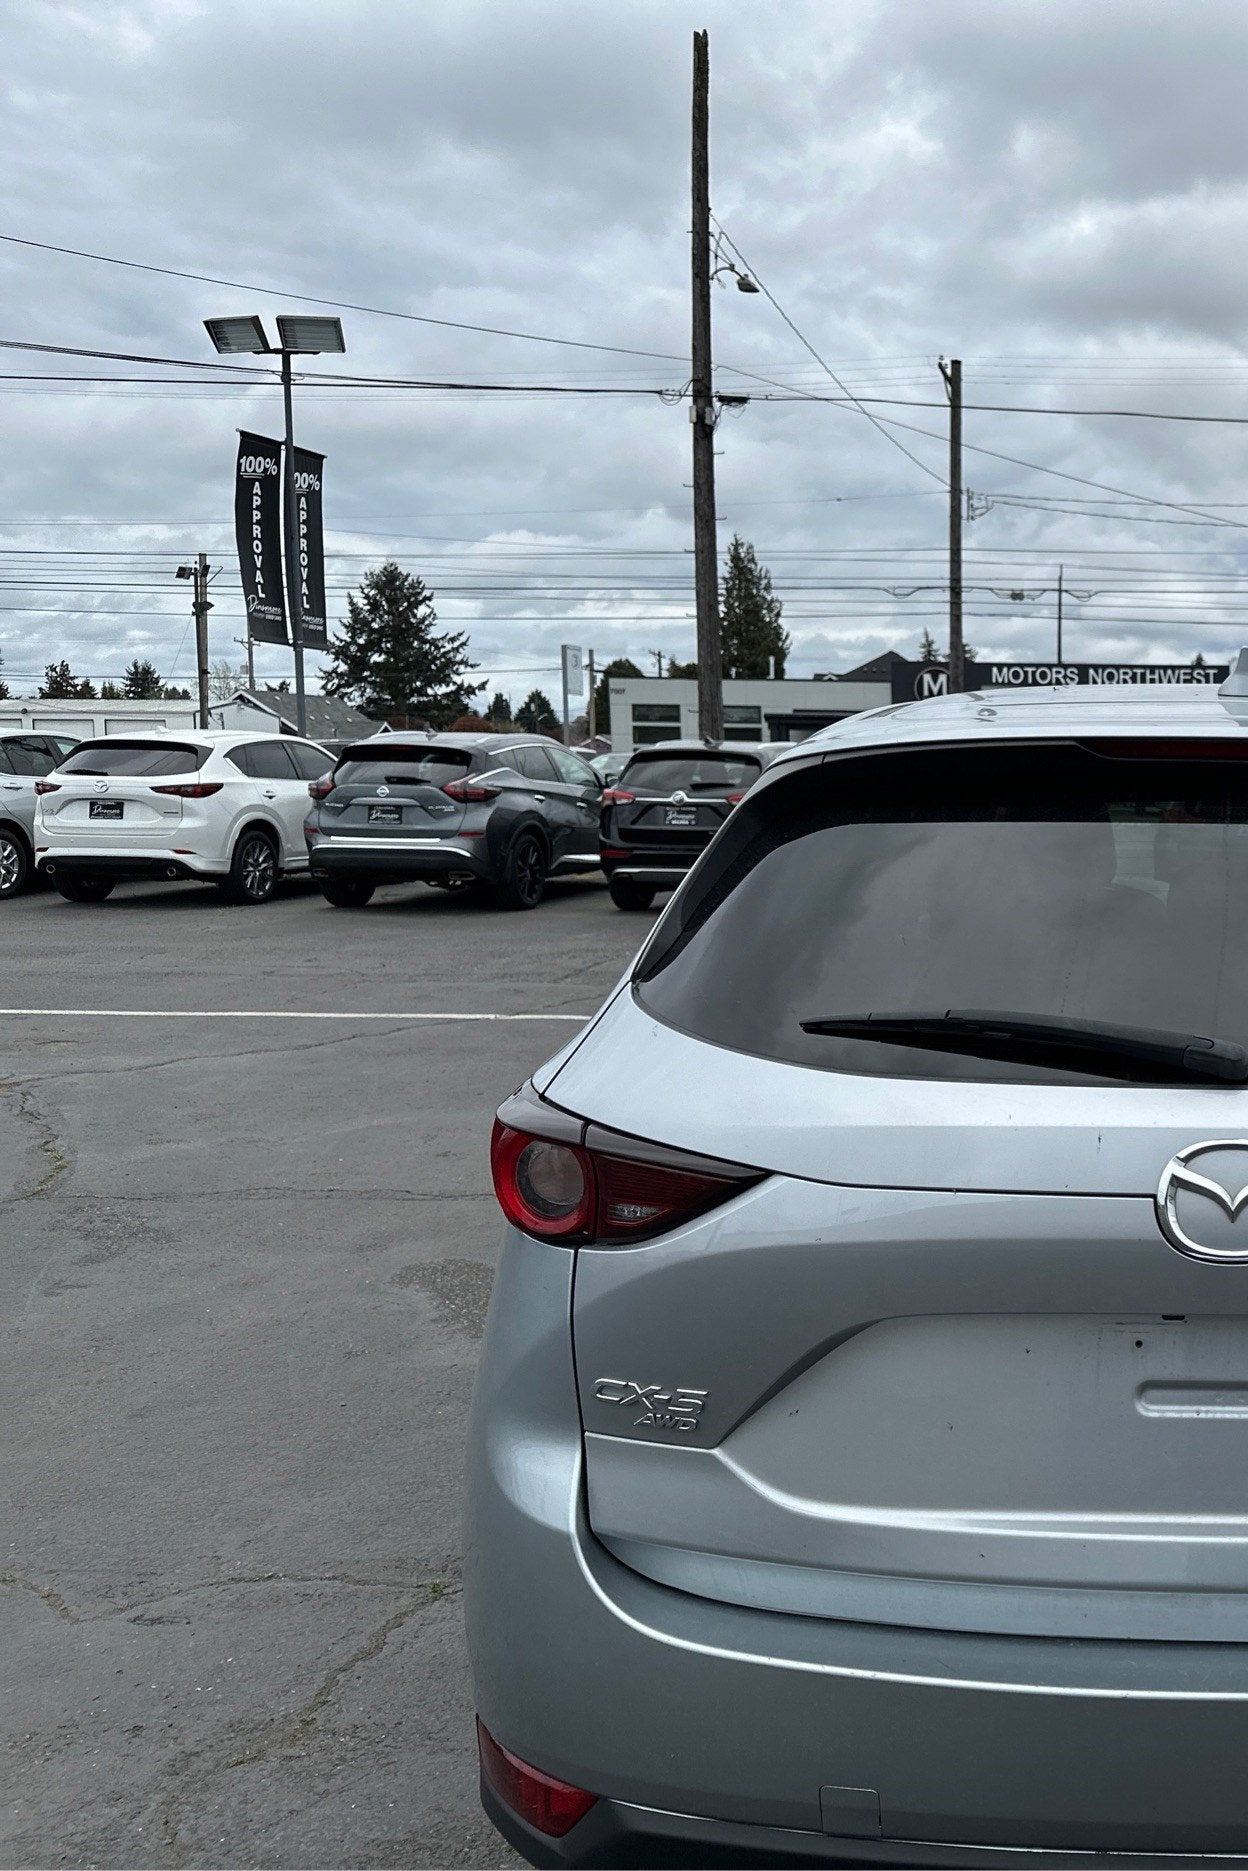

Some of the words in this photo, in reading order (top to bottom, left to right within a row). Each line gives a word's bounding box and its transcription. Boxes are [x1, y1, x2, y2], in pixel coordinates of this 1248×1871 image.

[239, 455, 278, 476] 100%
[294, 472, 320, 491] 00%
[252, 481, 266, 599] APPROVAL
[300, 496, 310, 609] APPROVAL
[991, 666, 1079, 686] MOTORS
[1088, 667, 1218, 686] NORTHWEST
[592, 1378, 710, 1415] CX-5
[633, 1413, 698, 1431] AWD
